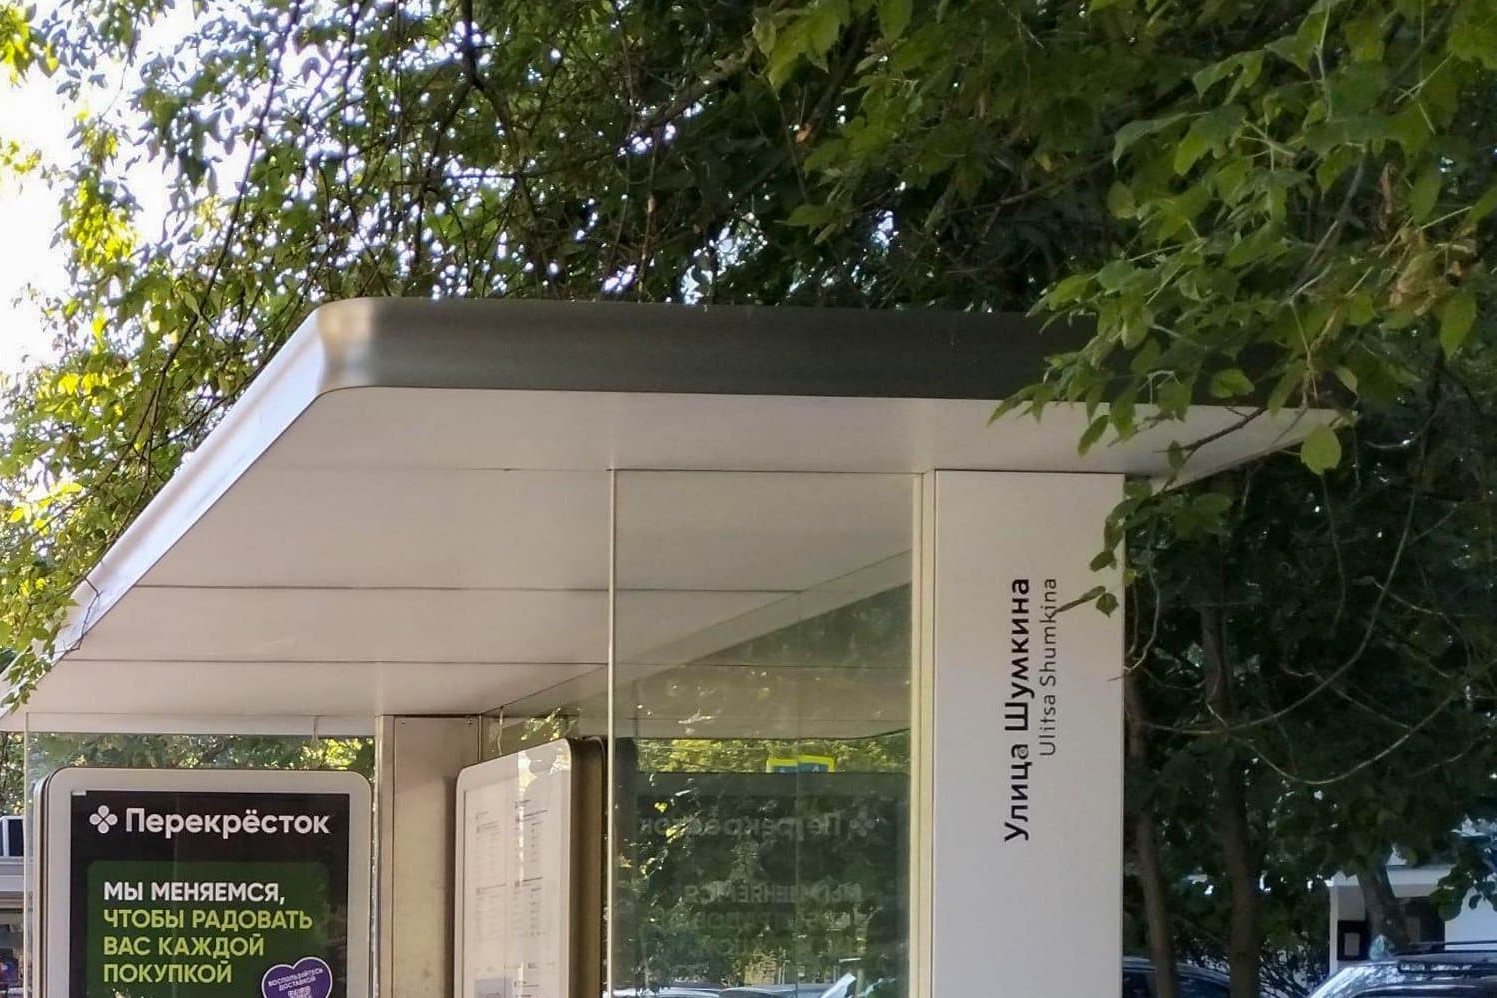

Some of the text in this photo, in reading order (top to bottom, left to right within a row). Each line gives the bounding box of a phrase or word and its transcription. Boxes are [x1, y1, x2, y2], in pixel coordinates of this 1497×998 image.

[1039, 577, 1057, 756] Ulitsa Shumkina
[1004, 578, 1035, 842] Улица Шумкина
[126, 807, 330, 839] Перекрёсток
[104, 881, 285, 905] МЫ МЕНЯЕМСЯ,
[103, 909, 313, 932] ЧТОБЫ РАДОВАТЬ
[104, 933, 264, 959] ВАС КАЖДОЙ
[103, 960, 233, 983] ПОКУПКОЙ
